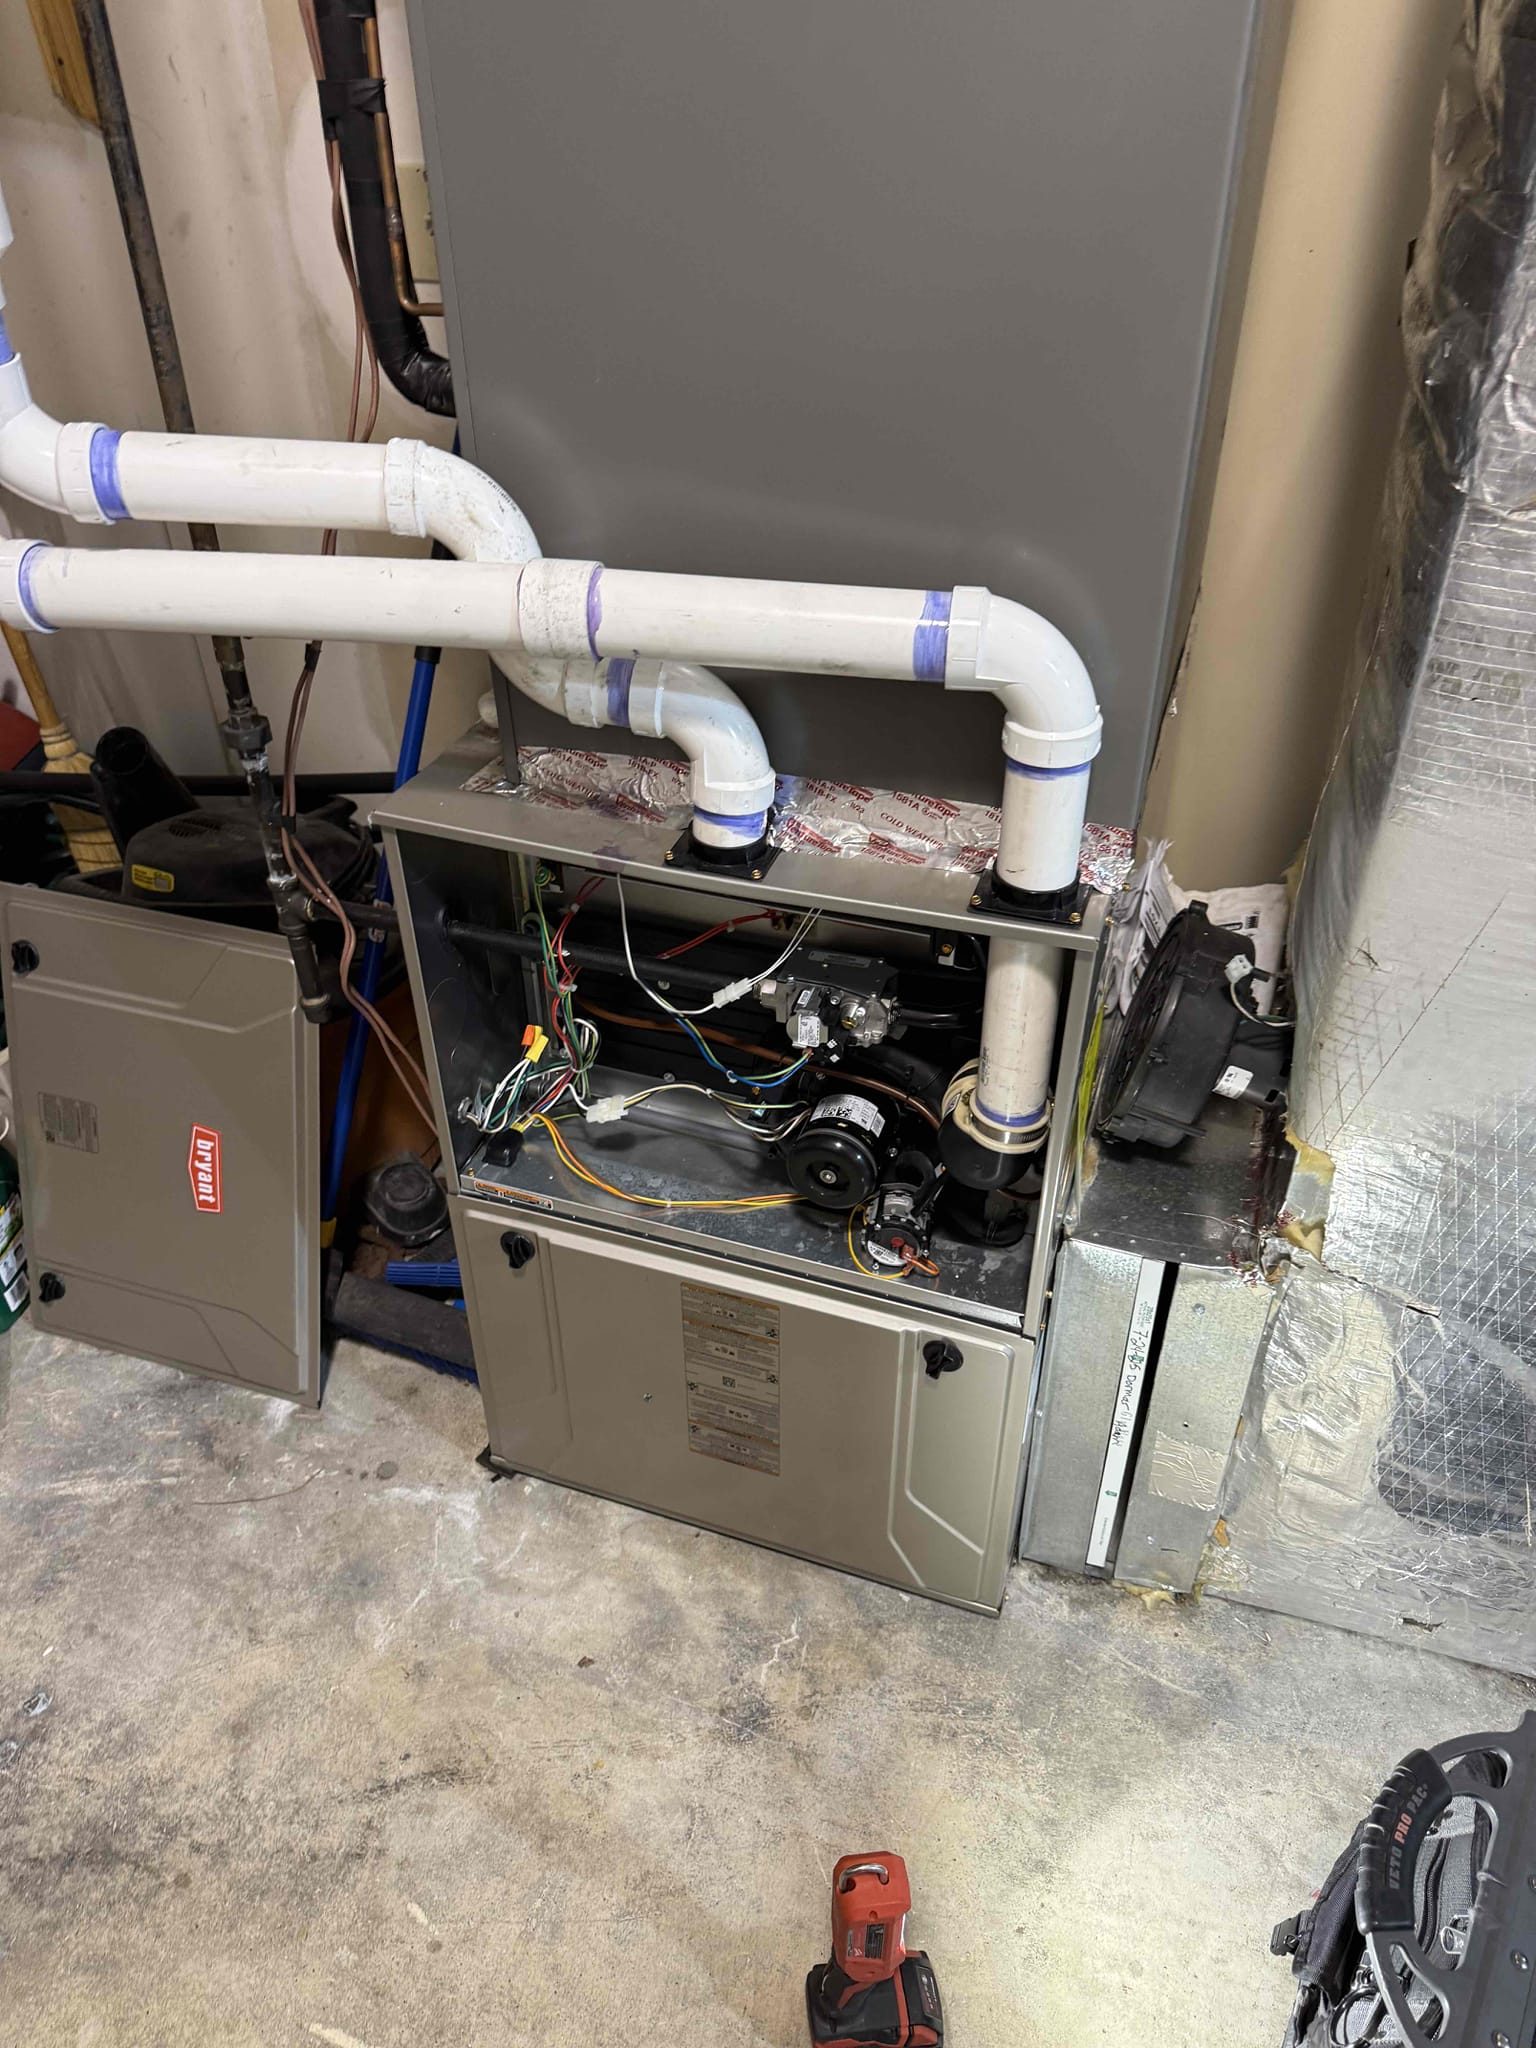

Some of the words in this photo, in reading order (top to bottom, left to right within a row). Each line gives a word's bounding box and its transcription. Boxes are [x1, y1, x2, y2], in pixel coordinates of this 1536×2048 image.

[880, 812, 904, 828] COLD
[904, 825, 944, 850] WEATHER
[194, 1138, 216, 1204] bryant
[1406, 1785, 1429, 1814] PAC
[1394, 1812, 1413, 1845] PRO
[1389, 1846, 1402, 1890] VETO
